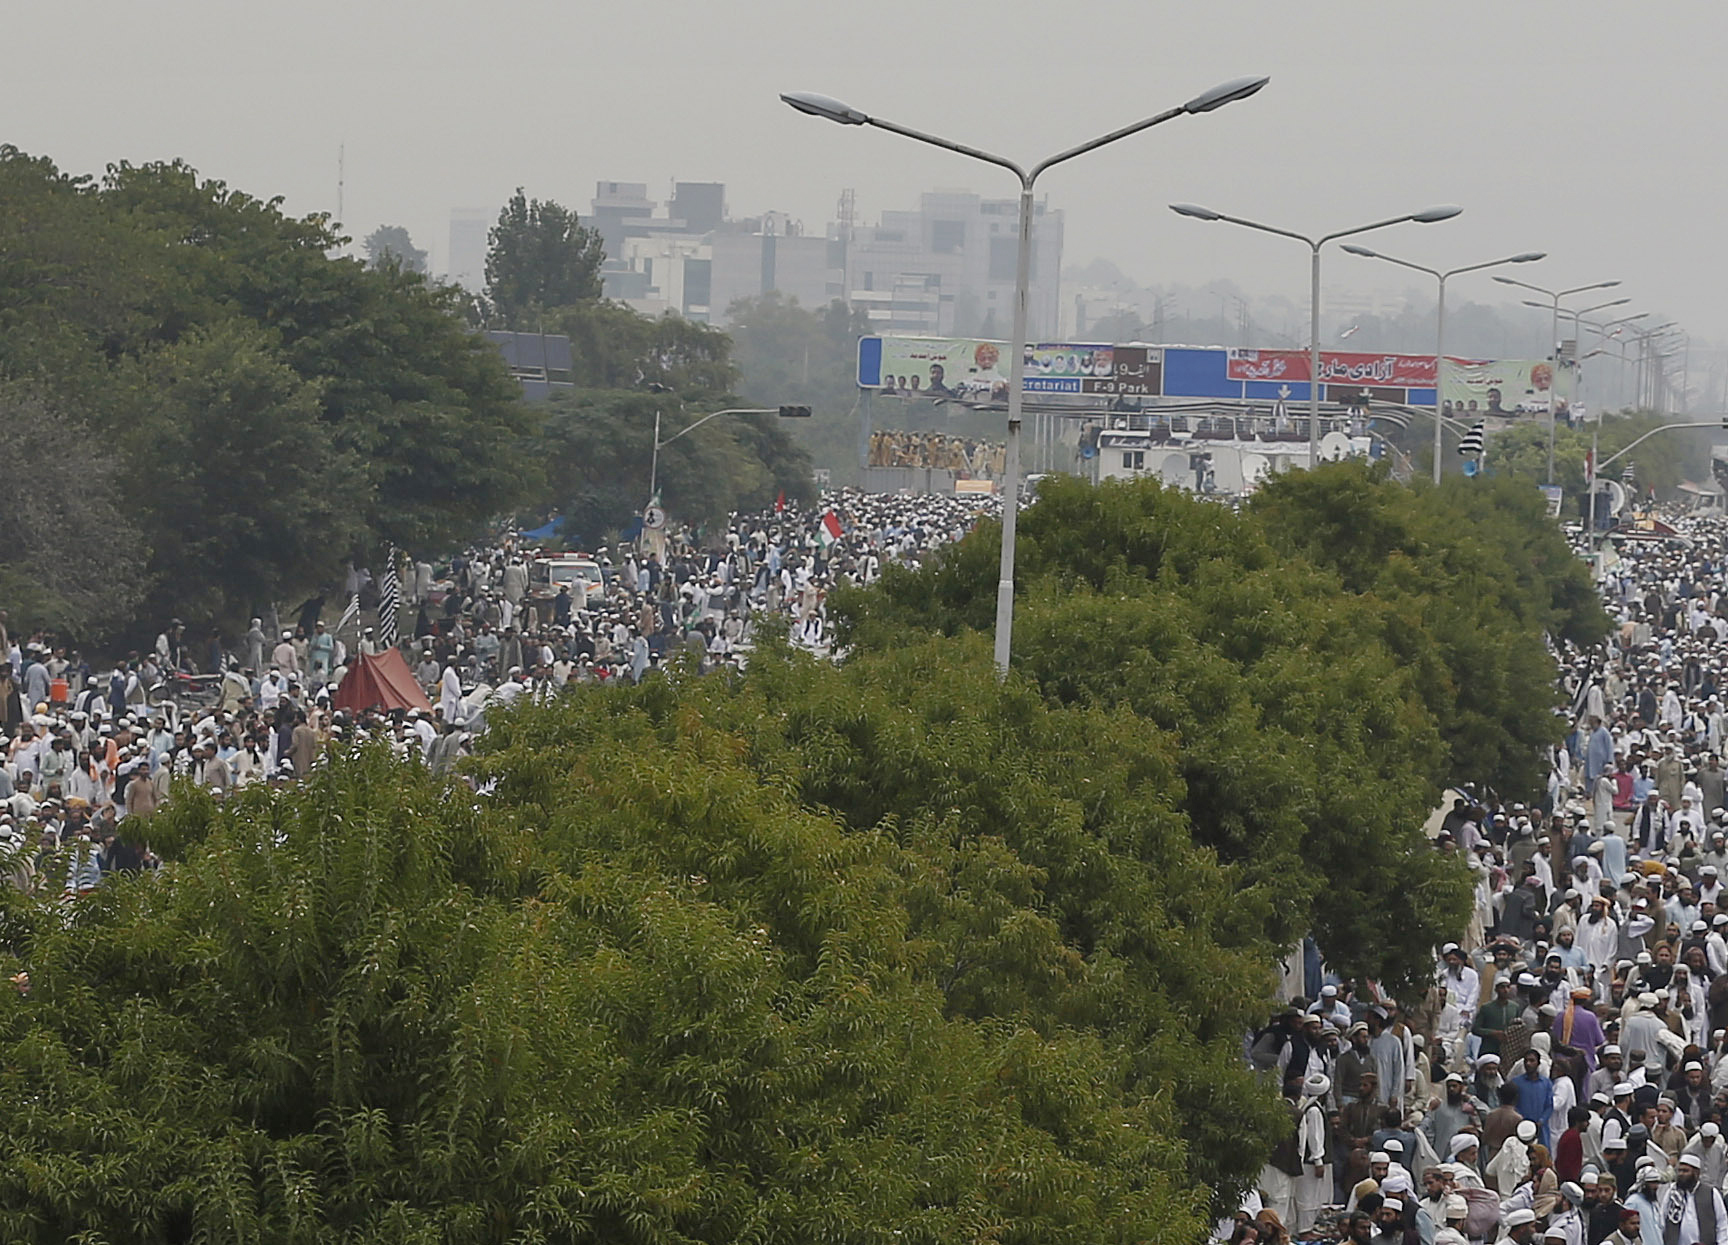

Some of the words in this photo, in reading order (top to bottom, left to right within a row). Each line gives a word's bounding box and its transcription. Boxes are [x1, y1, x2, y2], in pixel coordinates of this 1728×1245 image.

[1023, 380, 1078, 391] cretariat
[1094, 381, 1114, 392] F-9
[1118, 382, 1149, 394] Park
